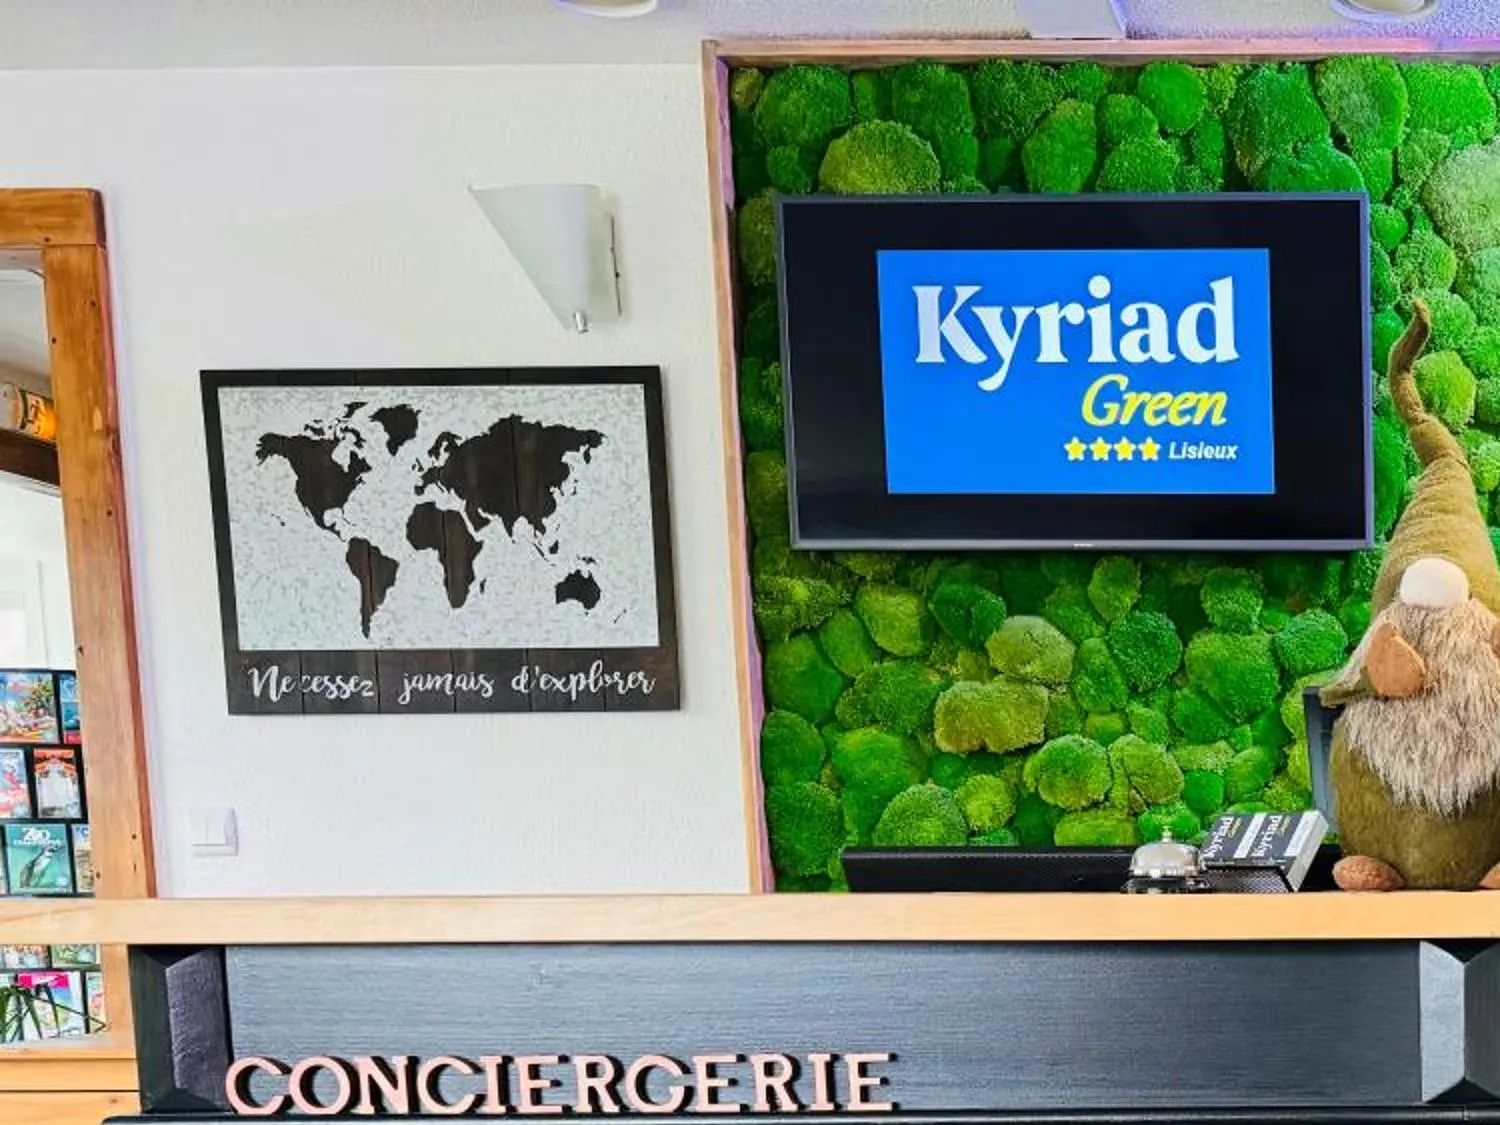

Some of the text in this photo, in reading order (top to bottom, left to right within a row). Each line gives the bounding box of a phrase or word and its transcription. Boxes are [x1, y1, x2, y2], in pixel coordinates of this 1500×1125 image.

[912, 274, 1240, 391] Kyriad
[1081, 373, 1229, 428] Green
[1168, 440, 1239, 460] Lisieux
[247, 659, 657, 705] Ne cessez jamais d'explorer
[1251, 814, 1283, 857] Kyriad
[225, 1053, 894, 1115] CONCIERGERIE
